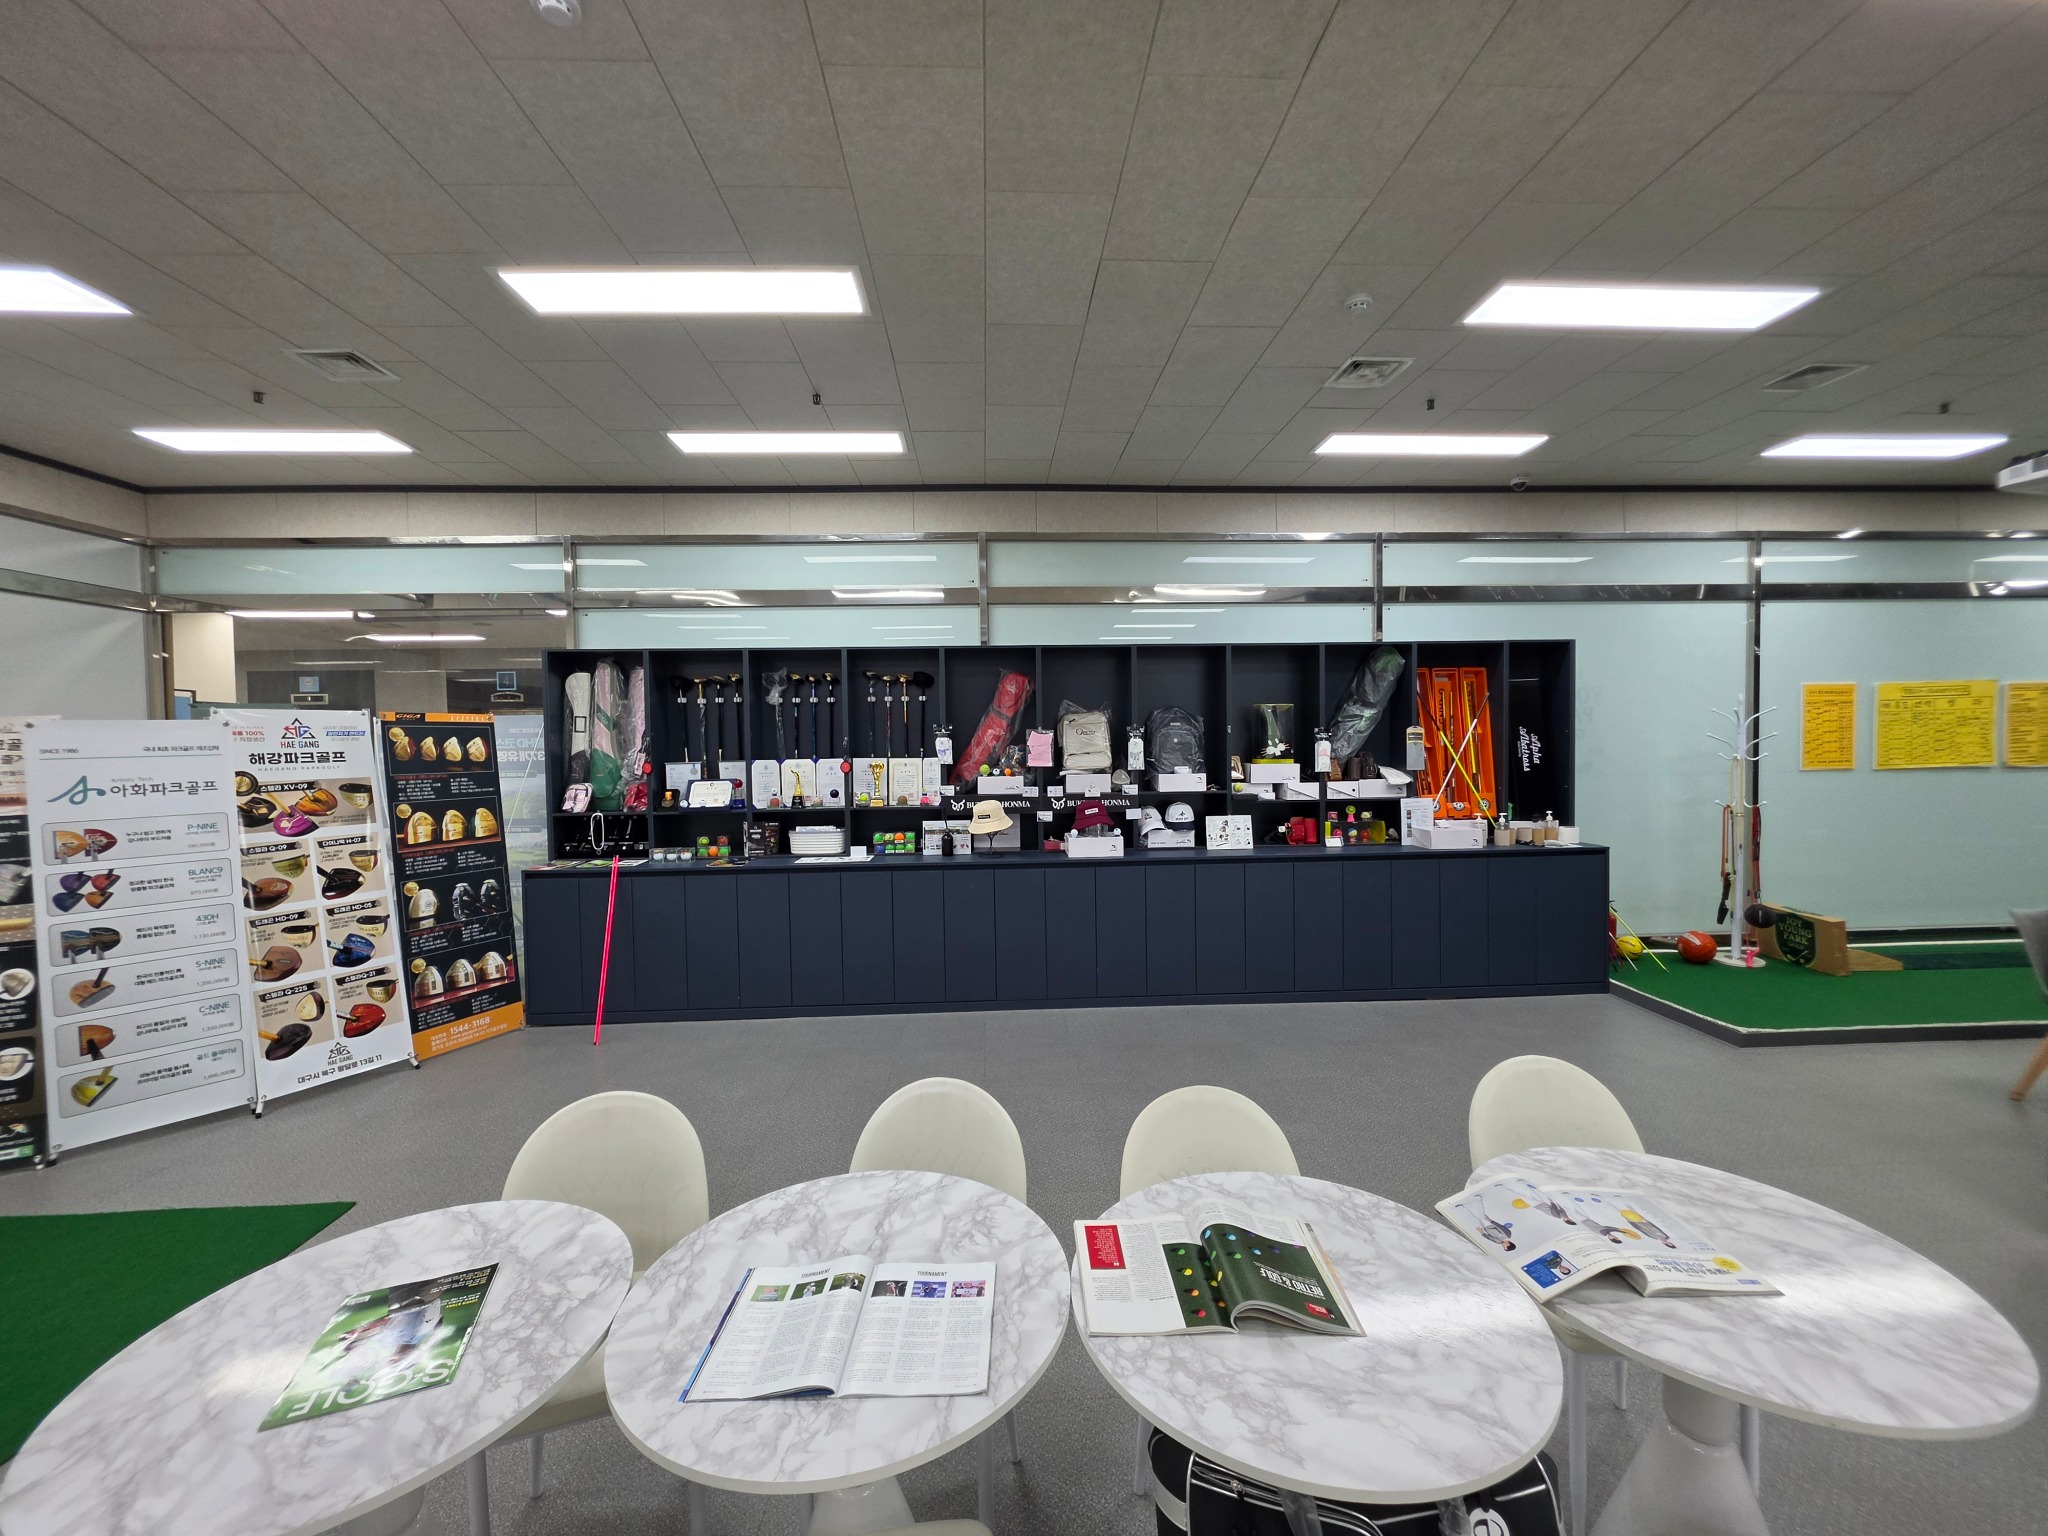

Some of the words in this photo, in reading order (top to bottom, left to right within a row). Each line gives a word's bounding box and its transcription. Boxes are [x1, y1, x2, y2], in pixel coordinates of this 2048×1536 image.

[503, 676, 510, 686] 4
[280, 740, 296, 749] HAE
[298, 740, 320, 749] GANG
[1519, 726, 1531, 772] Albatross
[1530, 733, 1542, 764] Alpha
[248, 752, 347, 765] 해강파크골프
[110, 780, 218, 798] 아화파크골프
[260, 783, 282, 792] 스텔라
[283, 783, 308, 791] XV-09
[1000, 800, 1031, 809] HONMA
[1101, 799, 1131, 807] HONMA
[187, 822, 219, 832] P-NINE
[346, 837, 361, 845] H-07
[249, 845, 269, 854] 스텔라
[269, 843, 288, 852] Q-09
[188, 866, 224, 876] BLANC9
[196, 913, 219, 922] 430H
[274, 913, 299, 923] HD-09
[1786, 917, 1803, 928] JOY
[1778, 922, 1812, 938] YOUNG
[1783, 931, 1808, 945] PARK
[195, 956, 226, 968] S-NINE
[264, 990, 284, 1000] 스텔라
[199, 1001, 230, 1013] C-NINE
[450, 1016, 491, 1035] 1544-3168
[327, 1058, 339, 1067] HAE
[339, 1053, 354, 1064] GANG
[297, 1072, 321, 1085] 대구시
[321, 1066, 336, 1077] 북구
[359, 1056, 375, 1067] 13길
[376, 1054, 383, 1062] 11
[800, 1268, 831, 1279] TOURNAMENT
[1258, 1267, 1283, 1283] GOLF
[1282, 1276, 1291, 1287] &
[1291, 1279, 1324, 1297] RETRO
